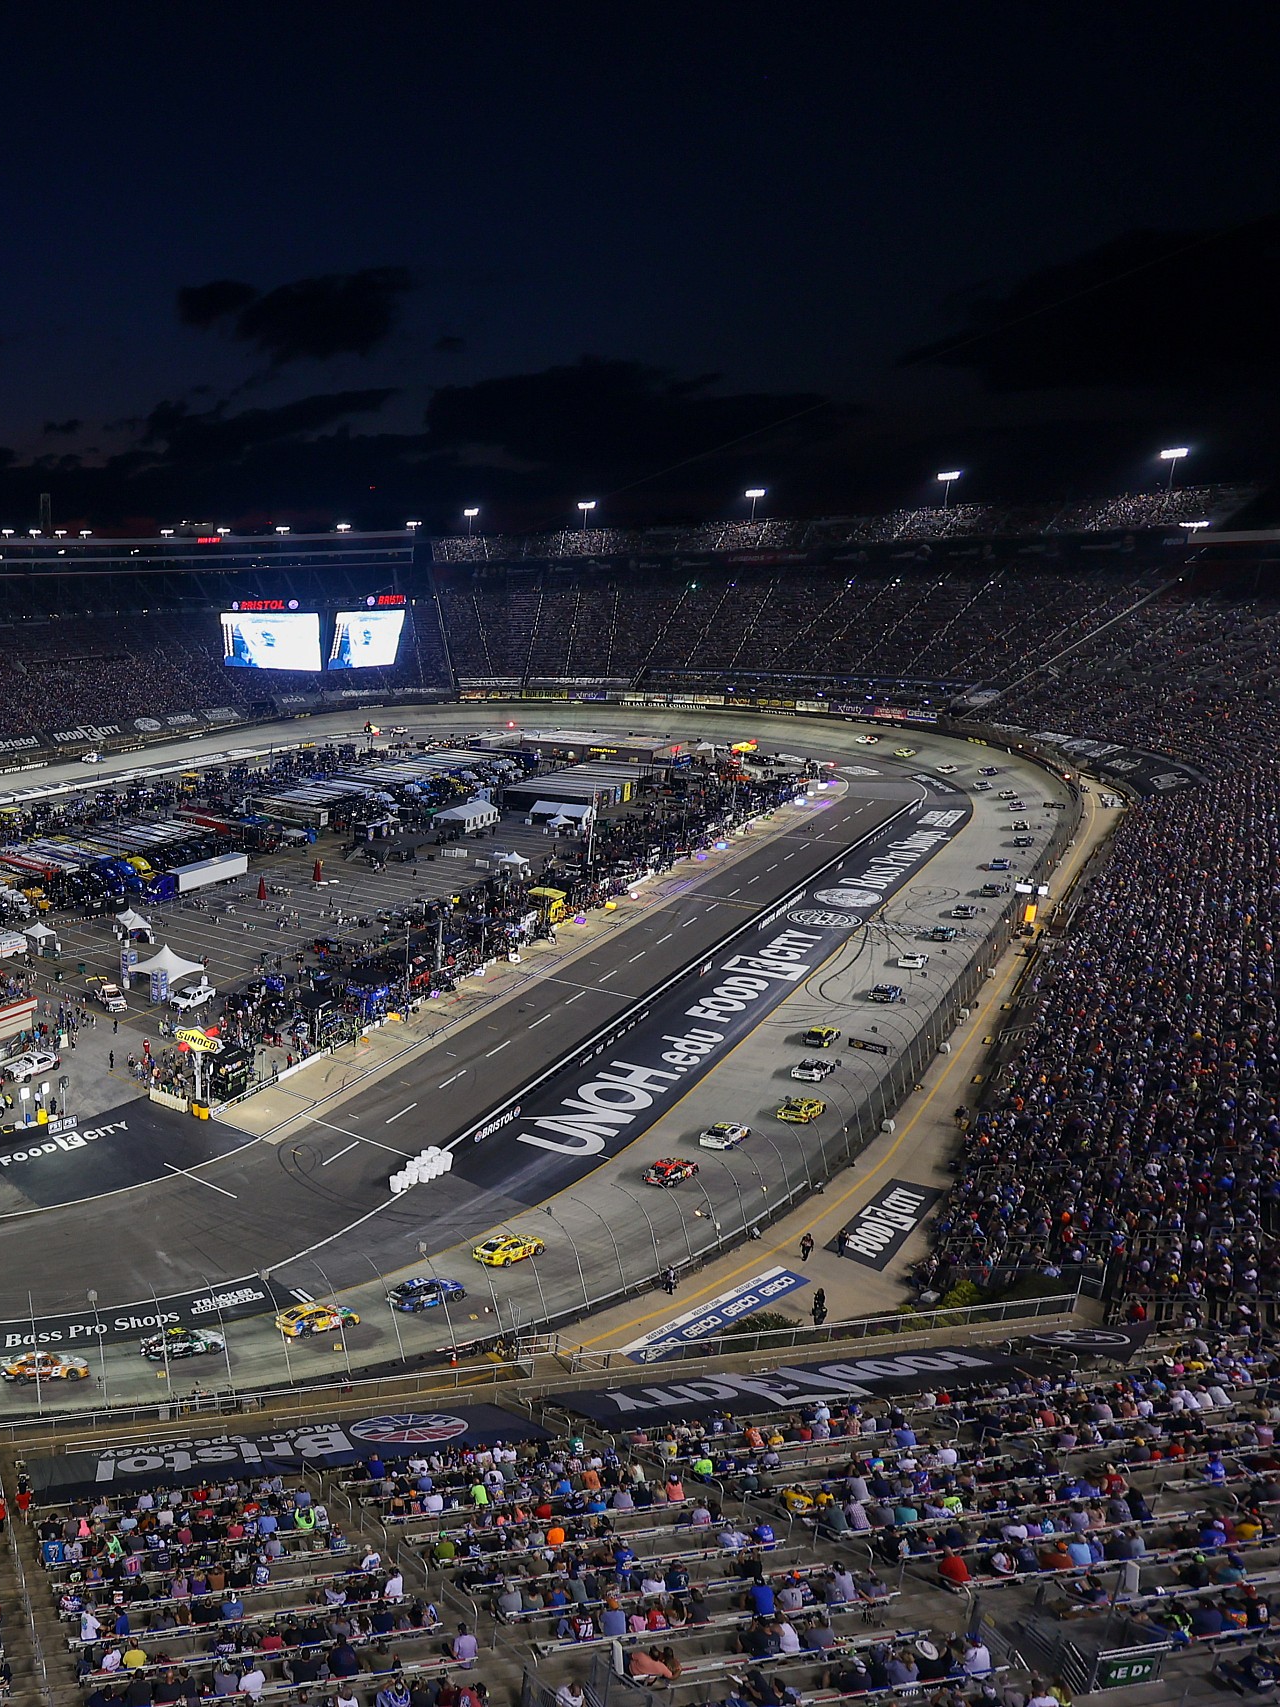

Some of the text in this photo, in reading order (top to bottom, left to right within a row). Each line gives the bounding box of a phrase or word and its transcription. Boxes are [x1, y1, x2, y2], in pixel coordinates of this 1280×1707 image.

[240, 600, 285, 610] BRISTOL
[575, 691, 599, 699] xfinity
[837, 704, 865, 713] xfinity
[906, 709, 938, 719] GEICO
[52, 730, 84, 742] FOOD
[97, 724, 122, 736] CITY
[4, 766, 21, 774] MOTOR
[838, 864, 905, 890] Bass
[886, 829, 953, 853] Shops
[176, 1030, 218, 1053] SUNOCO
[516, 1026, 724, 1156] UNOH.edu
[685, 973, 770, 1024] FOOD
[768, 928, 823, 964] CITY
[82, 1120, 129, 1141] CITY
[481, 1110, 514, 1139] BRISTOL
[845, 1187, 926, 1258] FOOD CITY
[735, 1277, 764, 1294] RESTART ZONE
[758, 1276, 797, 1297] GEICO
[191, 1287, 254, 1306] TRACKER
[192, 1300, 224, 1314] BOATS
[720, 1295, 761, 1318] GEICO
[691, 1299, 723, 1317] RESTART ZONE
[3, 1311, 180, 1348] Bass Pro Shops
[646, 1321, 679, 1341] RESTART ZONE
[682, 1315, 723, 1339] GEICO
[193, 1341, 206, 1352] 31
[640, 1337, 681, 1362] GEICO
[51, 1366, 61, 1377] 8
[605, 1349, 994, 1412] FOOD CITY
[99, 1422, 341, 1460] Motor Speedway
[94, 1429, 354, 1483] Bristol
